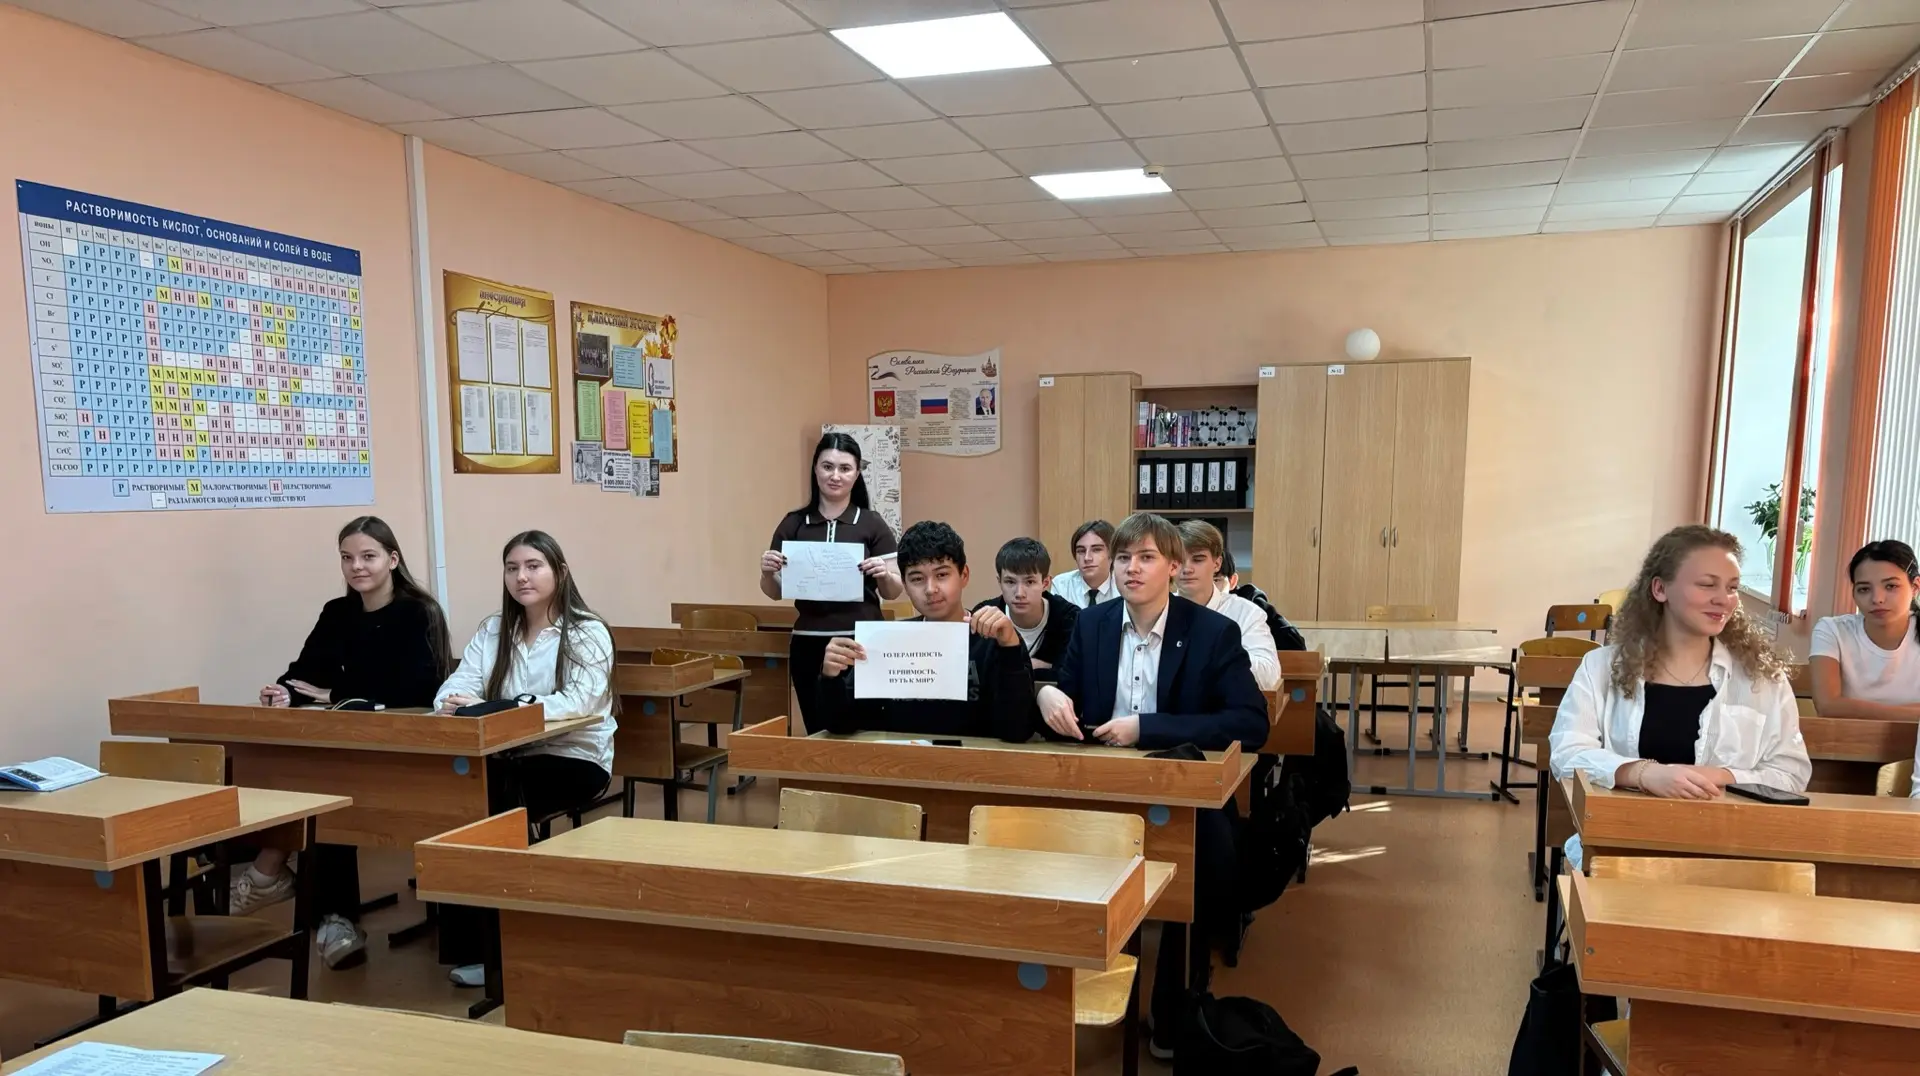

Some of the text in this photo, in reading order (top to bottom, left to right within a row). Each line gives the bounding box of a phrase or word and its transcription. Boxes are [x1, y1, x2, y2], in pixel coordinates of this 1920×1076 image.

[66, 200, 332, 262] РАСТВОРИМОСТЬ КИСЛОТ, ОСНОВАНИЙ И СОЛЕЙ В ВОДЕ
[84, 245, 89, 254] Р
[99, 248, 105, 257] Р
[115, 250, 120, 259] Р
[130, 253, 135, 262] Р
[158, 258, 164, 266] Р
[171, 260, 179, 269] М
[186, 262, 192, 271] Н
[199, 265, 205, 274] Н
[212, 267, 218, 276] Н
[225, 269, 231, 278] Н
[238, 272, 244, 280] Н
[71, 277, 76, 286] Р
[87, 279, 92, 288] Р
[102, 282, 108, 291] Р
[117, 284, 123, 292] Р
[132, 286, 138, 295] Р
[147, 288, 152, 297] Р
[160, 290, 168, 299] М
[174, 292, 181, 301] Н
[188, 294, 194, 303] Н
[201, 296, 208, 305] М
[214, 298, 221, 307] М
[228, 300, 234, 308] Н
[253, 304, 258, 312] Н
[80, 380, 85, 389] Р
[95, 381, 101, 390] Р
[111, 382, 116, 391] Р
[126, 383, 131, 392] Р
[141, 384, 146, 392] Р
[154, 385, 162, 394] М
[169, 386, 175, 395] Н
[182, 387, 189, 396] М
[197, 388, 202, 396] Р
[210, 389, 215, 397] Р
[223, 390, 228, 398] Р
[235, 391, 240, 399] Р
[248, 392, 253, 400] Р
[259, 393, 266, 401] М
[81, 396, 87, 406] Р
[97, 398, 102, 406] Р
[112, 399, 118, 407] Р
[127, 399, 133, 408] Р
[142, 400, 147, 409] Р
[155, 401, 163, 410] М
[169, 402, 177, 411] М
[184, 403, 190, 411] Н
[196, 404, 204, 412] М
[223, 405, 229, 413] Н
[87, 464, 93, 472] Р
[103, 464, 108, 472] Р
[118, 464, 124, 472] Р
[133, 464, 139, 472] Р
[148, 464, 153, 472] Р
[162, 465, 167, 473] Р
[176, 464, 181, 473] Р
[189, 465, 195, 473] Р
[203, 465, 208, 473] Р
[216, 465, 221, 473] Р
[229, 465, 233, 473] Р
[241, 465, 246, 473] Р
[253, 465, 258, 473] Р
[118, 483, 186, 493] Р РАСТВОРИМЫЕ
[190, 483, 199, 492] М
[273, 483, 279, 491] Н
